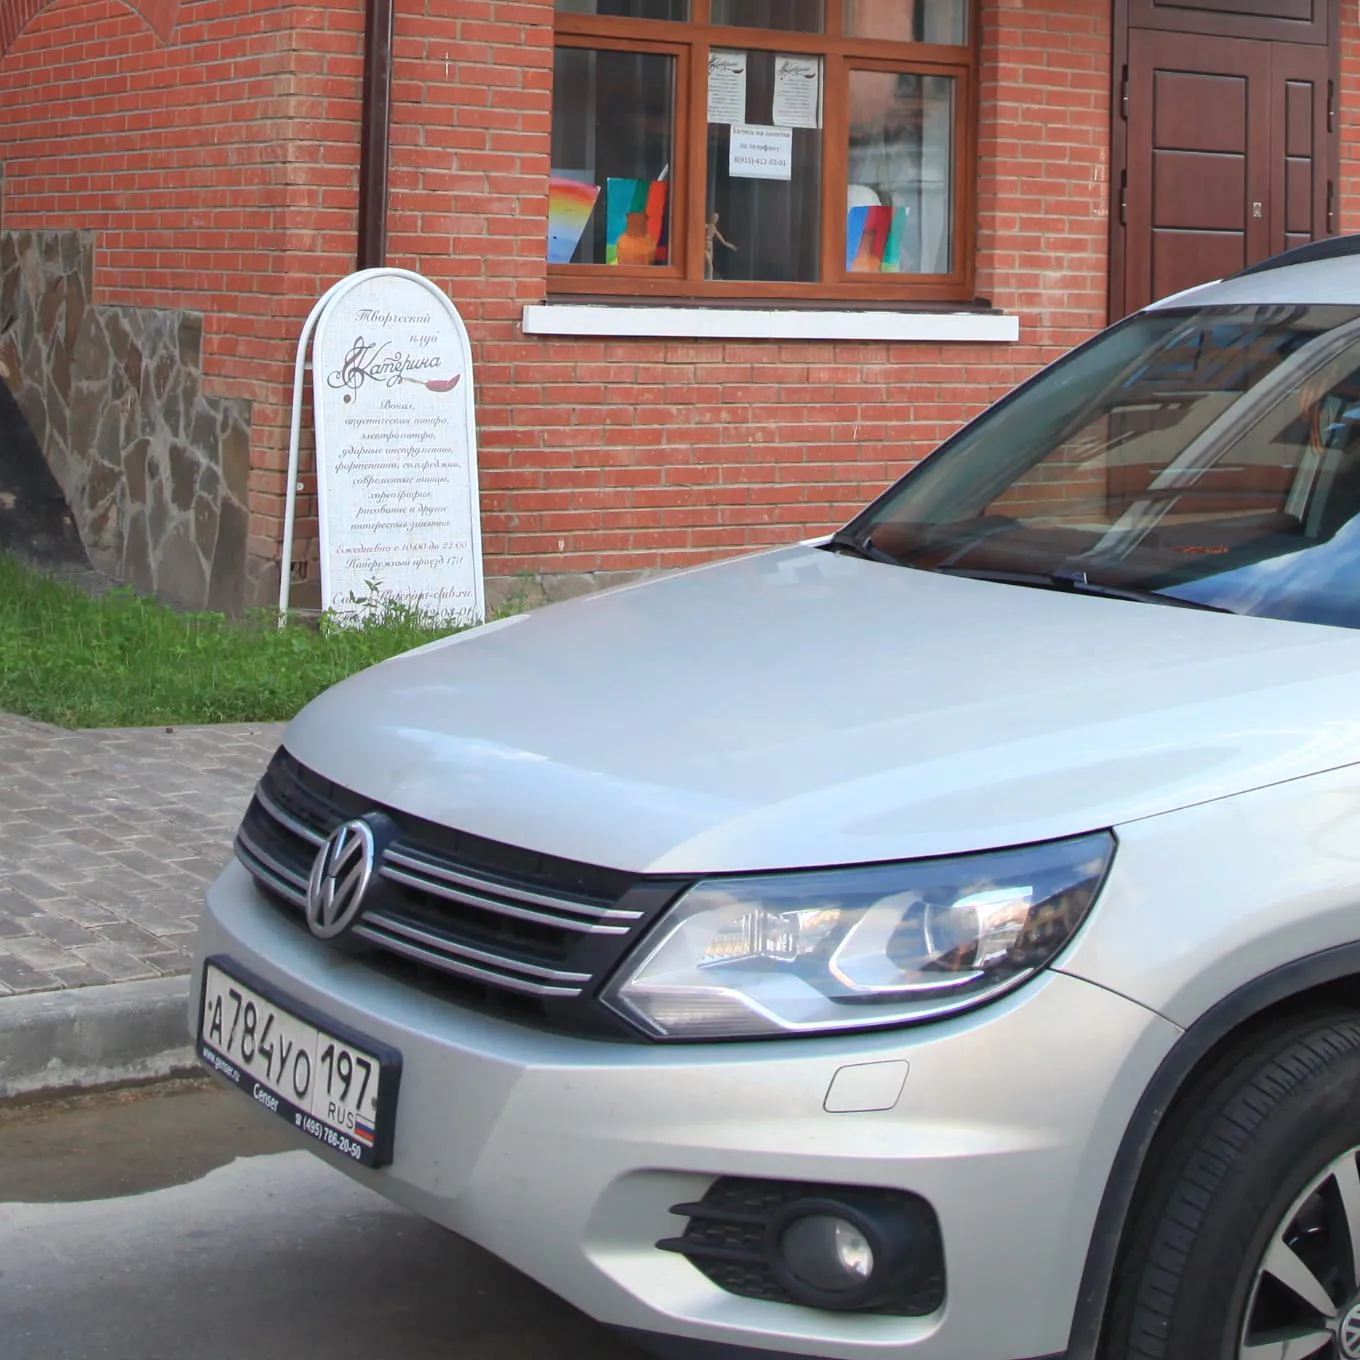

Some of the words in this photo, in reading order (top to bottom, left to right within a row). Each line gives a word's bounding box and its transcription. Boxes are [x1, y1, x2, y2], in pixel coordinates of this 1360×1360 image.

[354, 309, 431, 327] Творческий
[342, 337, 442, 388] Катерина
[321, 1043, 372, 1110] 197
[302, 1117, 323, 1139] (495)
[328, 1101, 354, 1129] RUS
